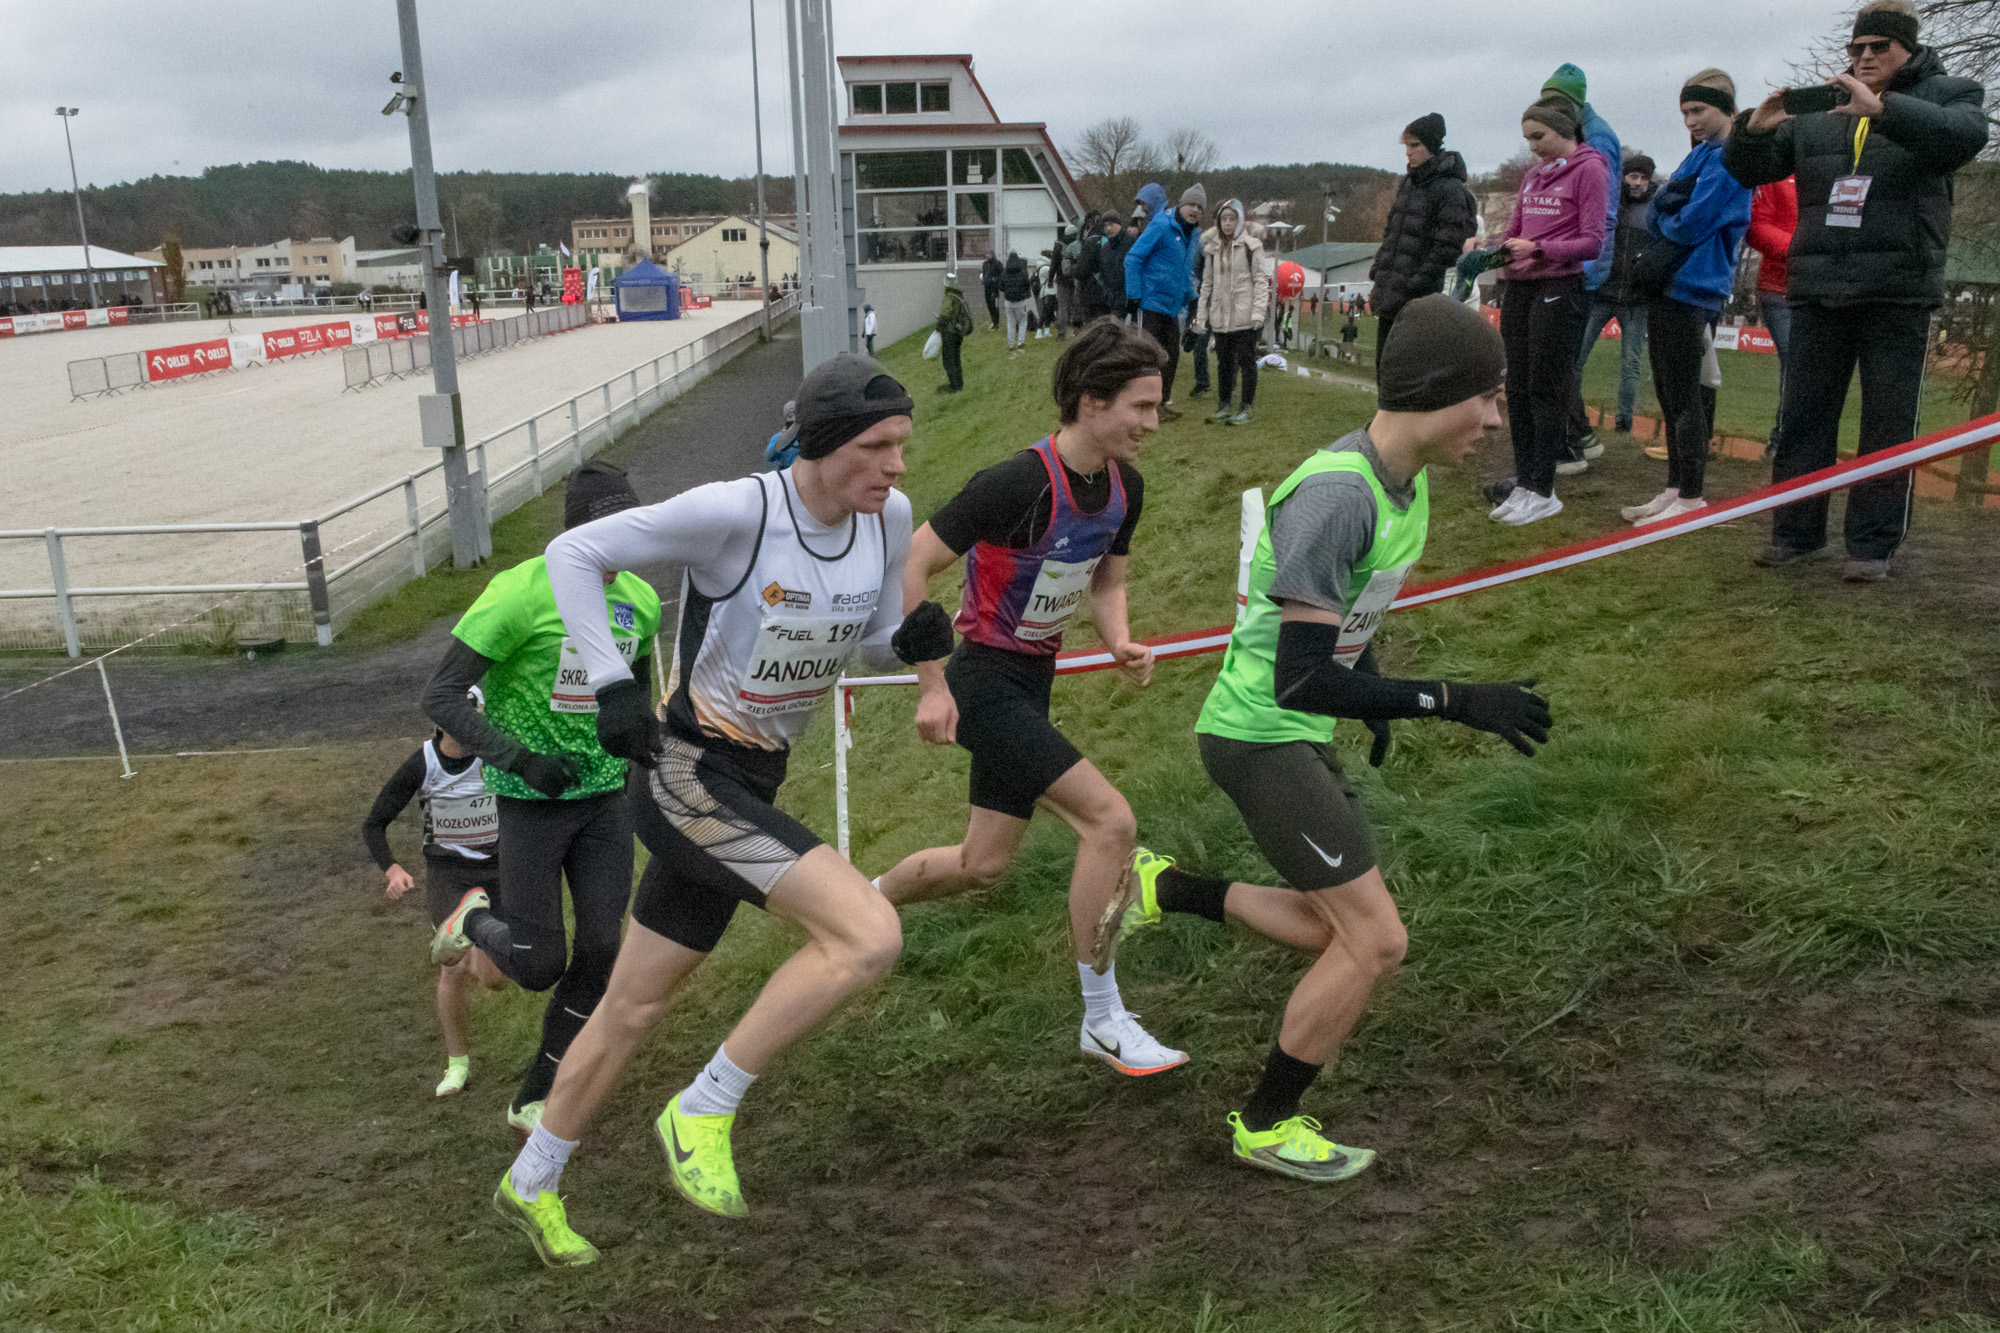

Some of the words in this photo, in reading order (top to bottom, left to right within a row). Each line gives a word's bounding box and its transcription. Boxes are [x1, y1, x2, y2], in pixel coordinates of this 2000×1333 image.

[277, 336, 295, 348] ORLEN
[299, 329, 322, 343] PZLA
[1716, 333, 1736, 342] SPORT
[1751, 337, 1774, 347] ORLEN
[207, 347, 229, 360] ORLEN
[166, 354, 190, 368] ORLEN
[785, 592, 810, 603] OPTIMA
[777, 629, 814, 641] FUEL
[827, 622, 863, 643] 191
[559, 669, 589, 686] SKRZ
[557, 702, 589, 710] ZIELONA
[746, 704, 786, 715] ZIELONA
[469, 795, 493, 809] 477
[435, 813, 497, 829] KOZŁOWSKI
